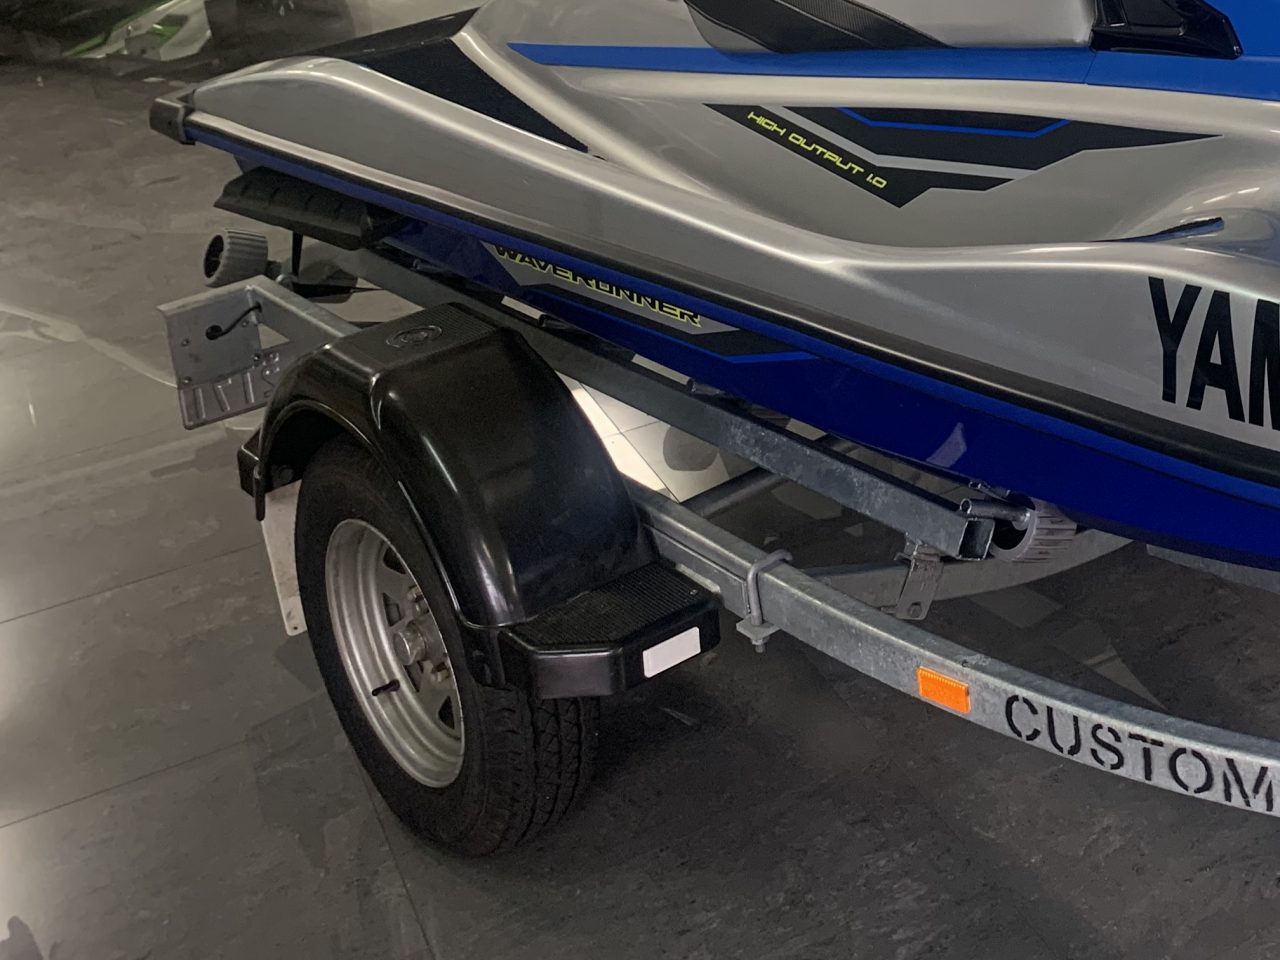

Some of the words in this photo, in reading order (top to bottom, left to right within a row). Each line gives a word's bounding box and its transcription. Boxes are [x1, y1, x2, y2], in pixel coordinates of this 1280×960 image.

[747, 111, 787, 136] HIGH
[788, 133, 865, 174] OUTPUT
[495, 244, 703, 328] WAVERUNNER
[1004, 693, 1274, 813] CUSTOM
